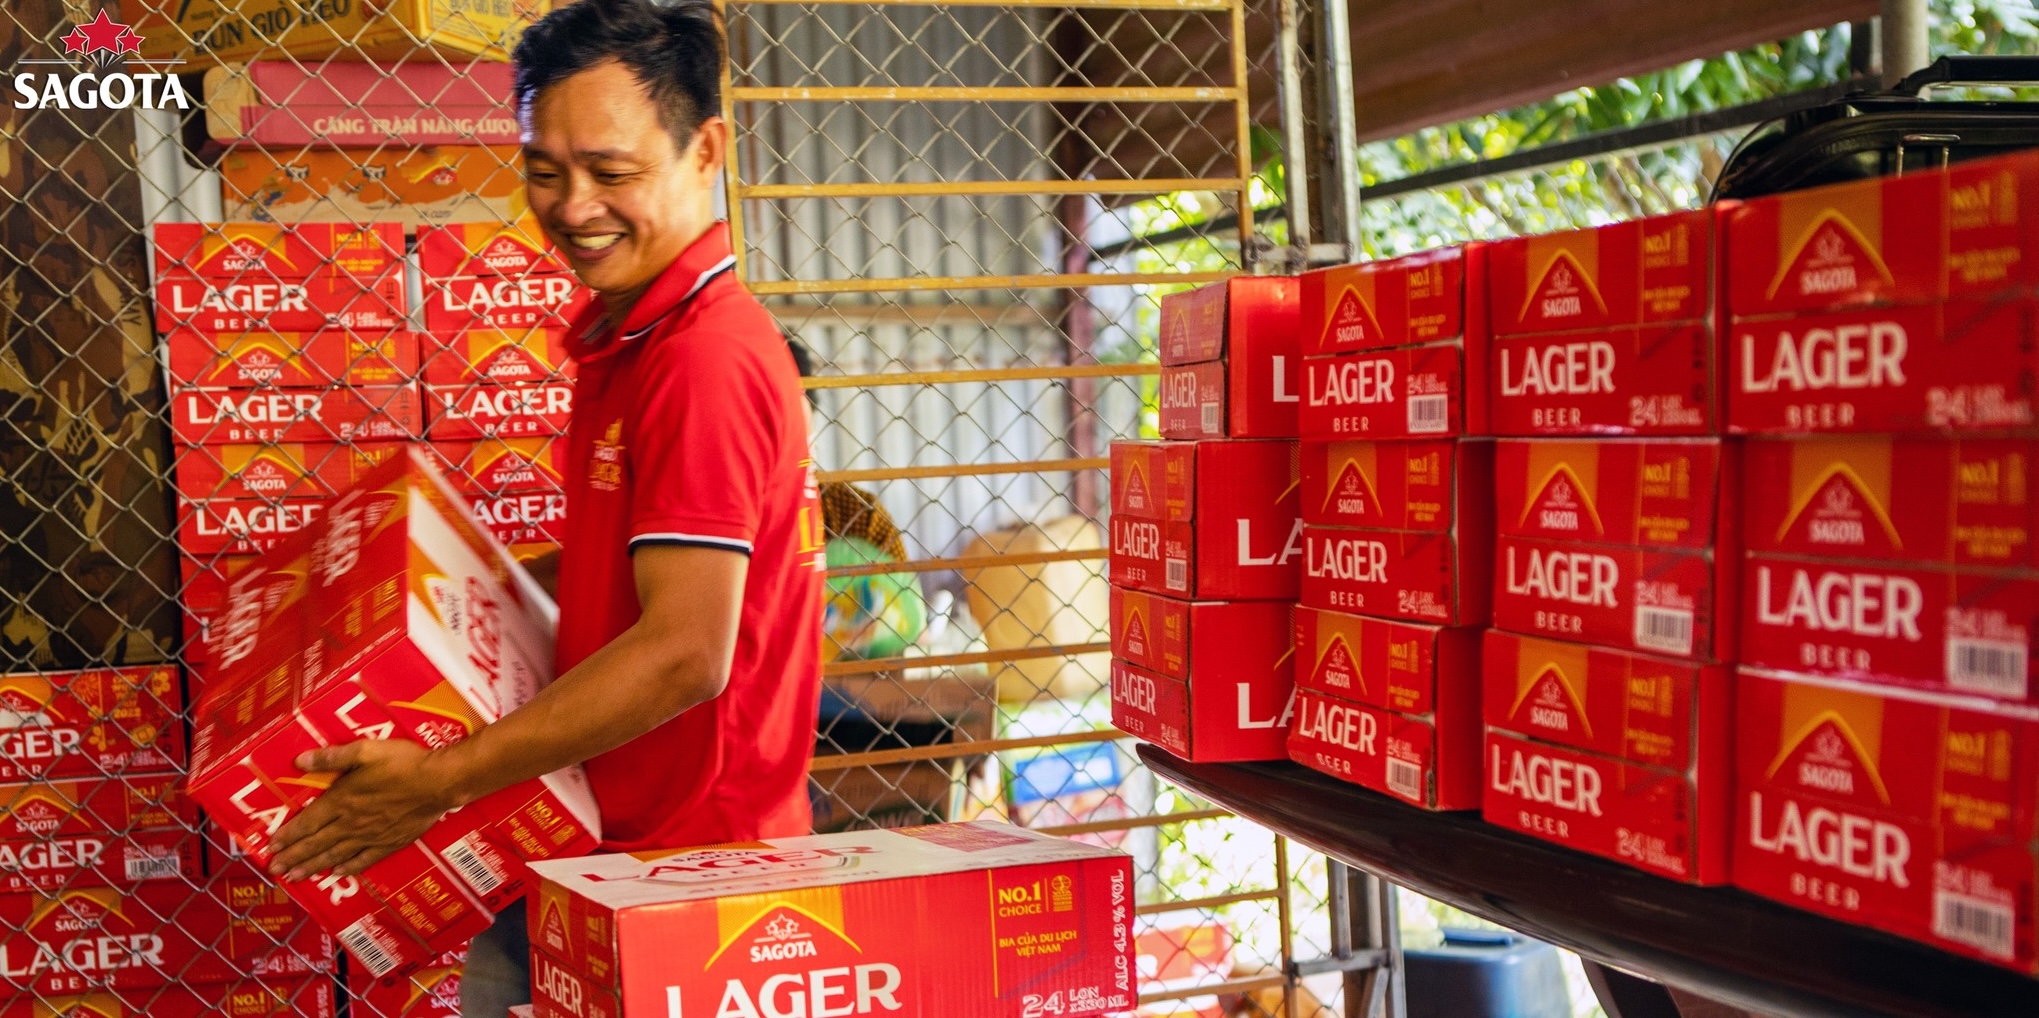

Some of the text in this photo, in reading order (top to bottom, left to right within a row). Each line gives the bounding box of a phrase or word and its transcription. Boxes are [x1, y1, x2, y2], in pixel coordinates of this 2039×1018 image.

[223, 258, 268, 271] SAGOTA
[485, 254, 528, 268] SAGOTA
[1410, 268, 1430, 287] NO.1
[1801, 265, 1857, 295] SAGOTA
[172, 283, 309, 314] LAGER
[443, 277, 573, 312] LAGER
[1541, 296, 1581, 318] SAGOTA
[215, 318, 270, 330] BEER
[484, 313, 537, 326] BEER
[1336, 327, 1365, 343] SAGOTA
[1501, 341, 1616, 397] LAGER
[1742, 320, 1908, 394] LAGER
[238, 367, 283, 381] SAGOTA
[488, 363, 531, 377] SAGOTA
[1162, 371, 1197, 408] LAGER
[1308, 358, 1395, 407] LAGER
[188, 393, 323, 425] LAGER
[445, 387, 573, 420] LAGER
[1785, 402, 1855, 429] BEER
[484, 422, 538, 434] BEER
[1333, 416, 1369, 432] BEER
[1532, 407, 1581, 428] BEER
[229, 428, 284, 441] BEER
[1409, 456, 1427, 473] NO.1
[1645, 462, 1671, 482] NO.1
[242, 477, 287, 491] SAGOTA
[492, 471, 536, 484] SAGOTA
[473, 494, 567, 526] AGER
[1337, 498, 1364, 514] SAGOTA
[1540, 510, 1578, 531] SAGOTA
[1809, 519, 1865, 546] SAGOTA
[1114, 520, 1160, 560] LAGER
[1306, 537, 1388, 583] LAGER
[1127, 566, 1146, 581] BEER
[1507, 546, 1619, 608] LAGER
[1330, 590, 1364, 608] BEER
[1757, 565, 1923, 643] LAGER
[1535, 610, 1583, 633] BEER
[1801, 642, 1871, 672] BEER
[1112, 666, 1156, 716] LAGER
[1325, 670, 1351, 690] SAGOTA
[1125, 715, 1144, 733] BEER
[1299, 696, 1377, 756] LAGER
[1531, 705, 1568, 731] SAGOTA
[0, 728, 81, 760] GER
[1316, 752, 1352, 775] BEER
[1492, 743, 1603, 818] LAGER
[1799, 761, 1854, 796] SAGOTA
[1519, 810, 1569, 838] BEER
[1750, 790, 1911, 889] LAGER
[0, 839, 105, 870] AGER
[580, 845, 883, 882] LAGER
[672, 850, 761, 862] SAGOTA
[998, 881, 1042, 904] NO.1
[1790, 870, 1860, 911] BEER
[999, 903, 1042, 917] CHOICE
[999, 930, 1077, 948] BIA CỦA DU LỊCH
[1016, 943, 1061, 958] VIỆT NAM
[0, 933, 165, 977] LAGER
[750, 940, 817, 963] SAGOTA
[534, 952, 584, 1018] LAGER
[1115, 955, 1129, 991] ALC
[232, 991, 265, 1006] NO.1
[1022, 986, 1100, 1018] 24 LON
